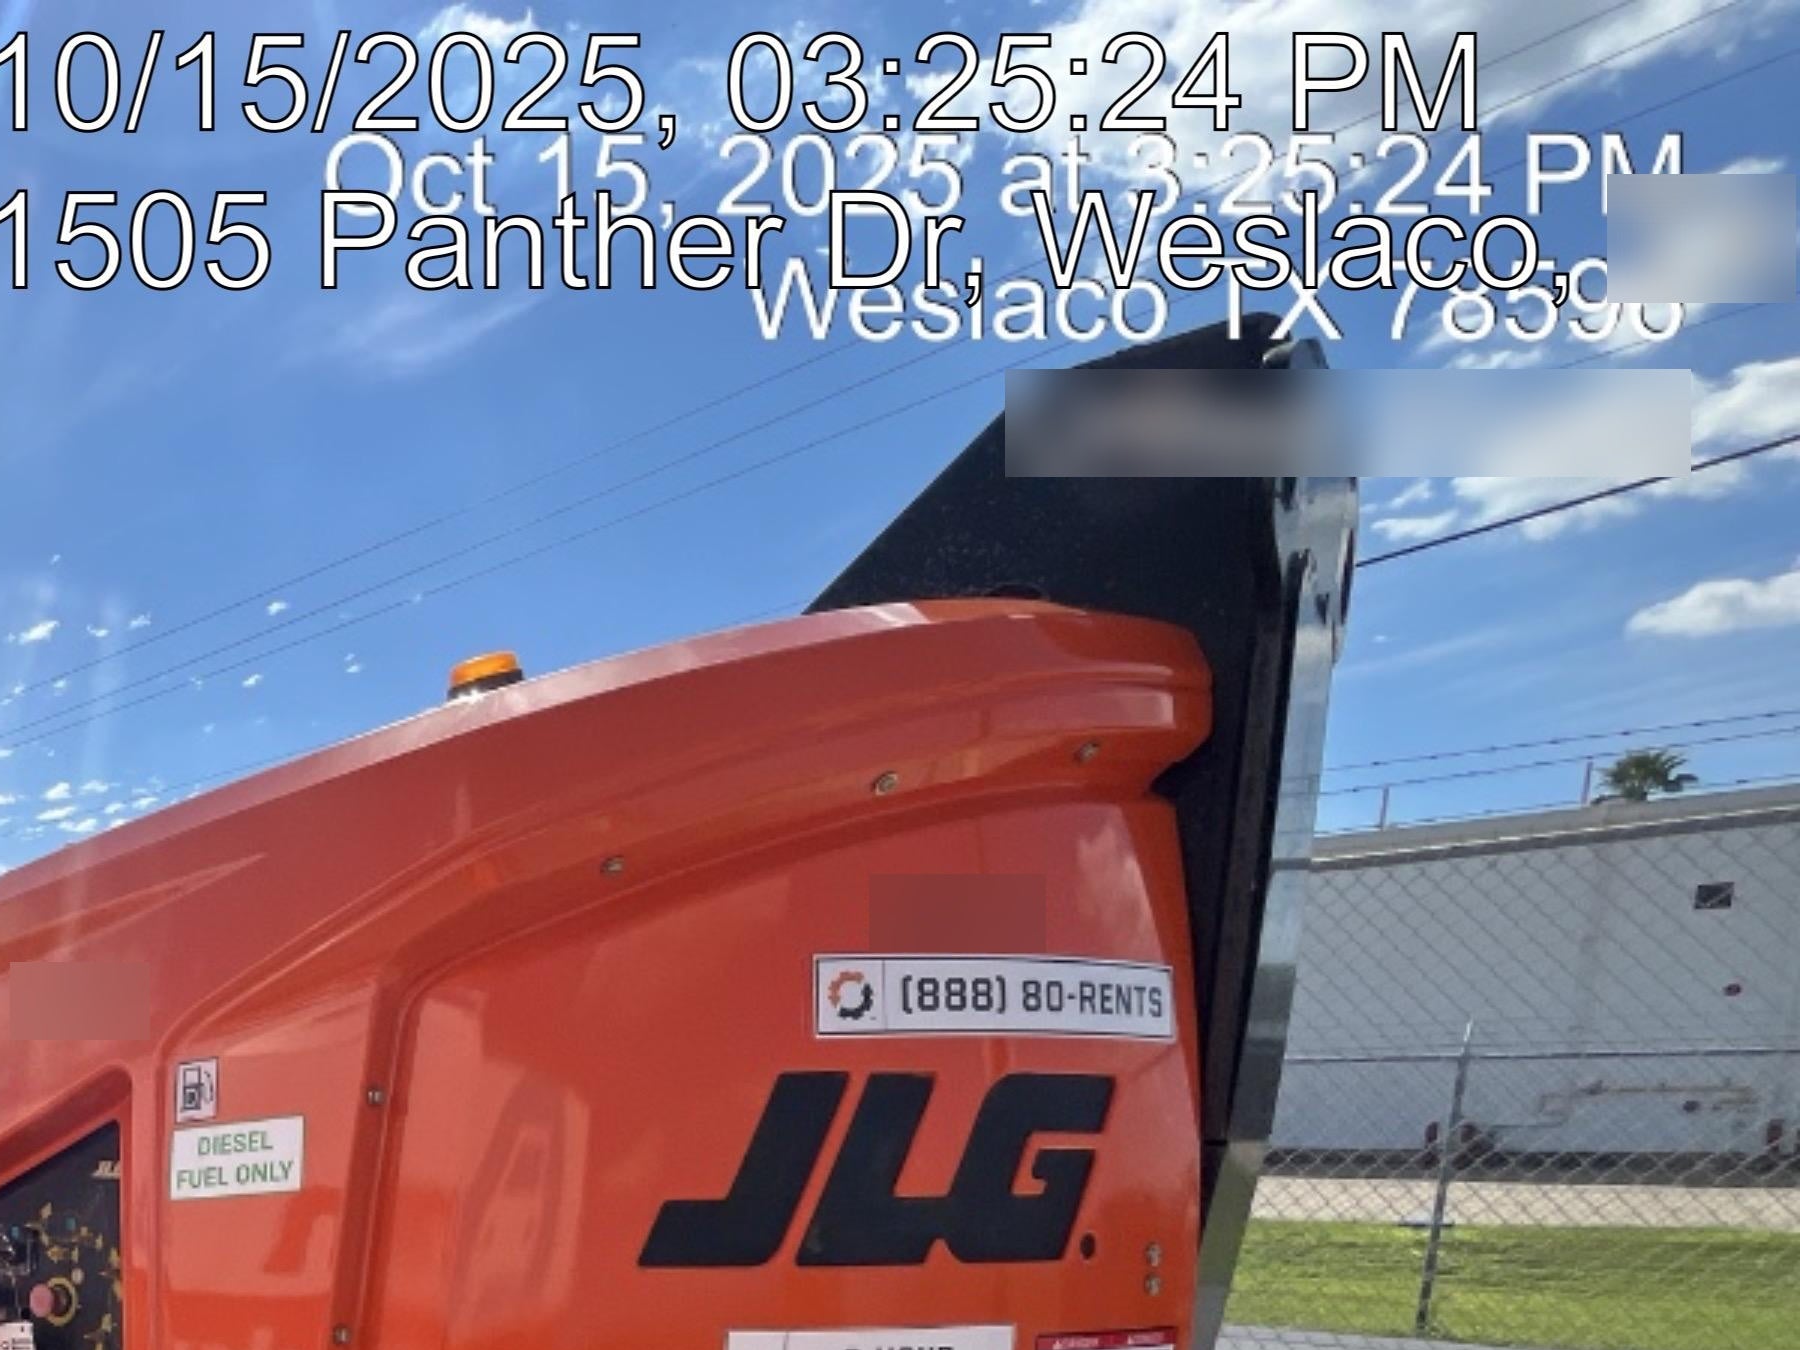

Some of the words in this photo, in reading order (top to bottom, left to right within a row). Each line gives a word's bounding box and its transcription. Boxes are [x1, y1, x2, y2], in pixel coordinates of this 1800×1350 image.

[901, 974, 1007, 1014] (888)
[1022, 979, 1163, 1018] 80-RENTS
[197, 1130, 274, 1156] DIESEL
[176, 1166, 228, 1190] FUEL
[236, 1160, 294, 1184] ONLY
[637, 1070, 1117, 1266] JLG
